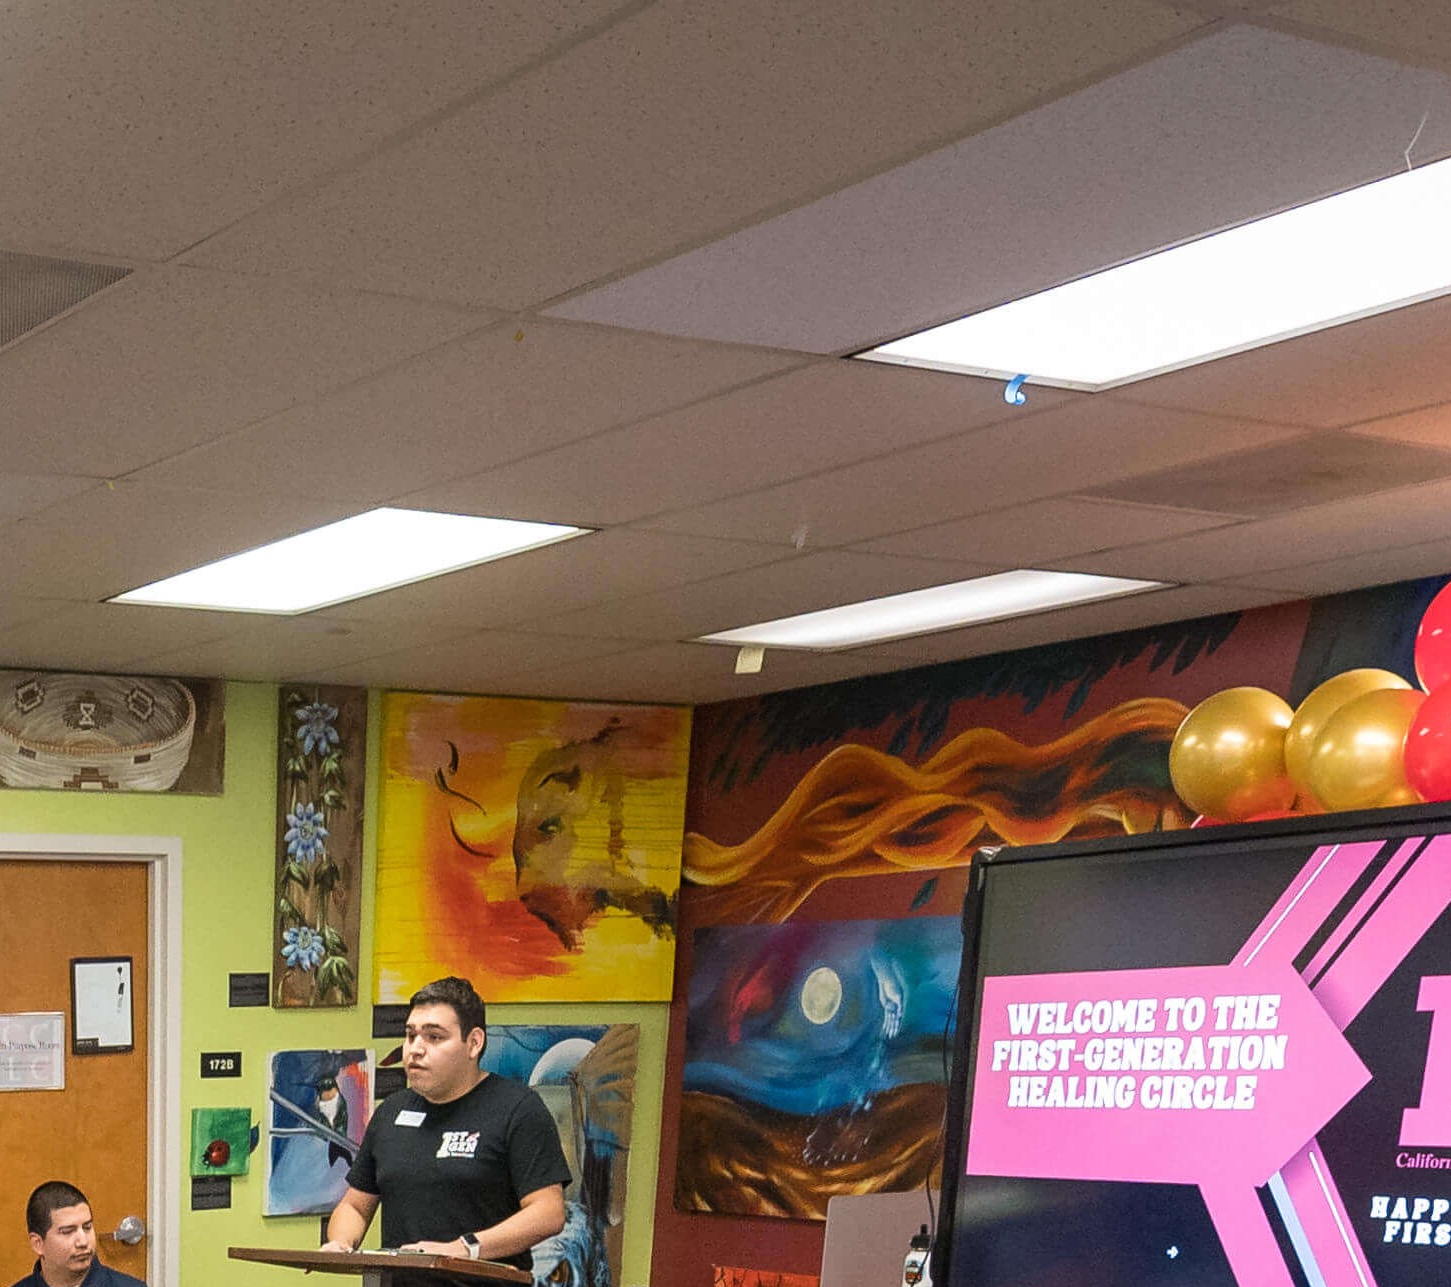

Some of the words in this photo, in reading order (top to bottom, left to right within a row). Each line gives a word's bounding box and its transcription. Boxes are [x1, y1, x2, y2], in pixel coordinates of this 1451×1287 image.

[1007, 999, 1158, 1035] WELCOME
[1164, 997, 1206, 1032] TO
[1212, 994, 1282, 1031] THE
[209, 1059, 235, 1071] 172B
[991, 1035, 1289, 1072] FIRST-GENERATION
[1007, 1075, 1138, 1109] HEALING
[1140, 1075, 1258, 1110] CIRCLE
